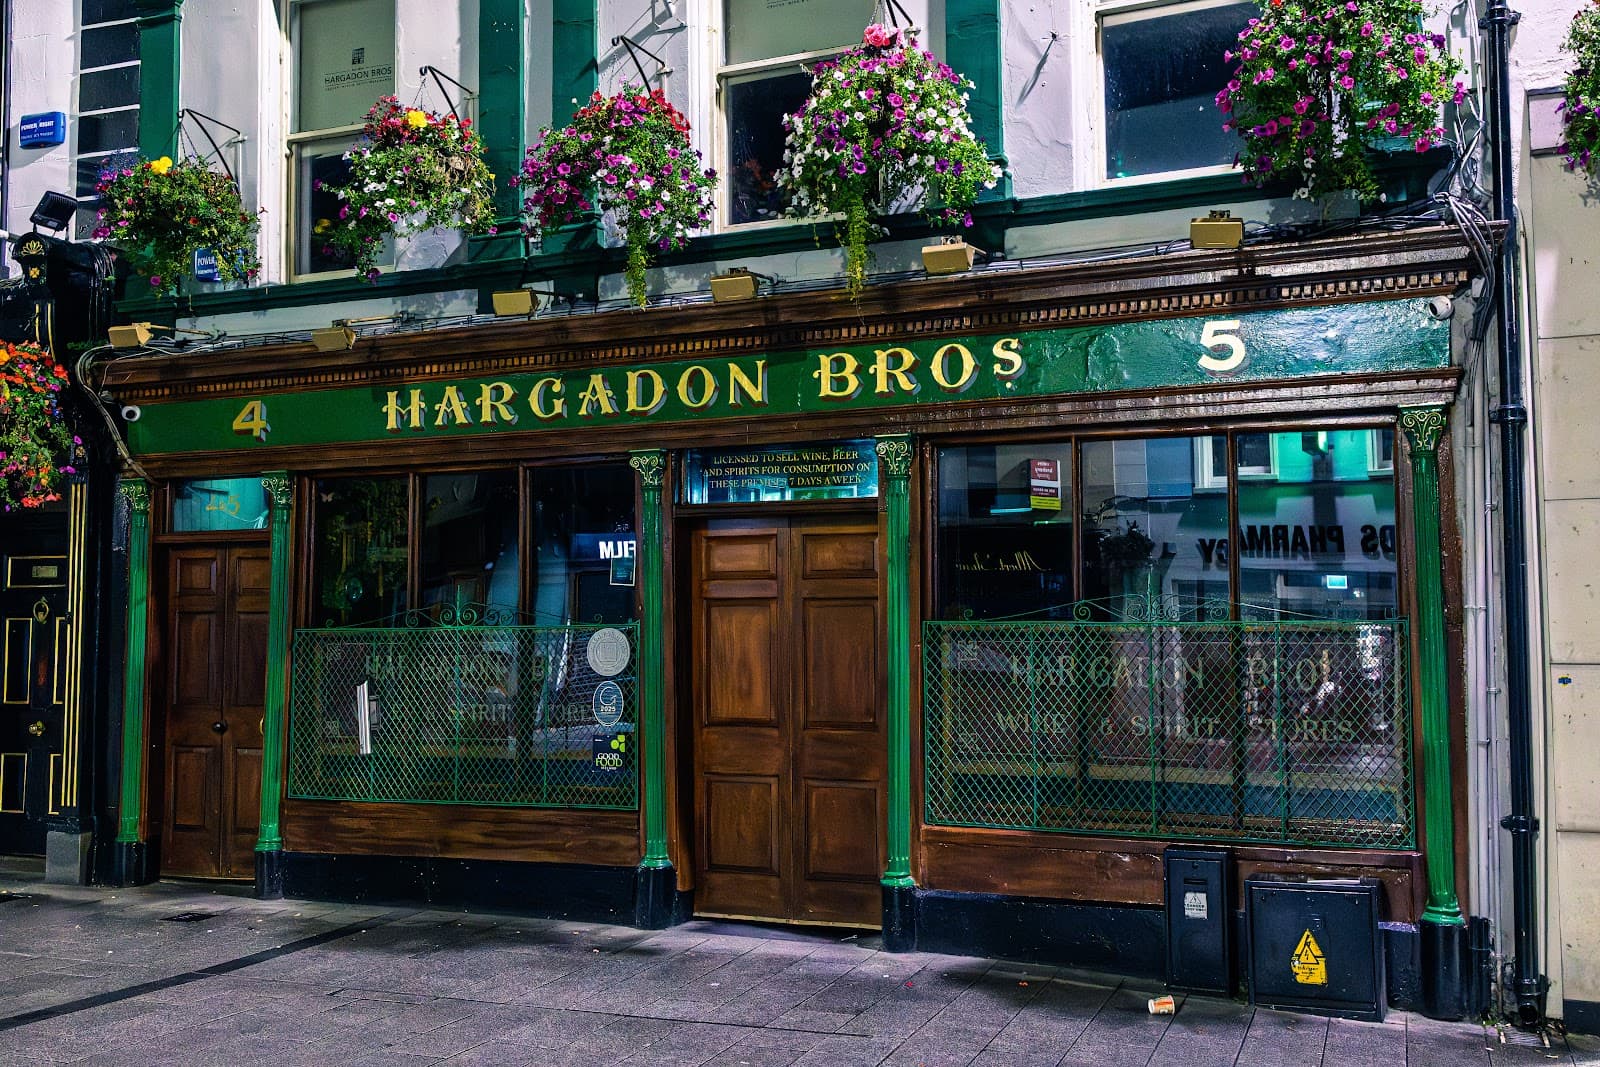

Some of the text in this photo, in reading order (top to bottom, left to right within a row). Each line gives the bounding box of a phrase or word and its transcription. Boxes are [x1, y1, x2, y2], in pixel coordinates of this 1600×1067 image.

[324, 70, 369, 85] HARGADON
[371, 66, 392, 77] BROS
[1198, 319, 1247, 376] 5
[382, 359, 768, 433] HARGADON
[232, 400, 270, 441] 4
[713, 454, 759, 465] LICENSED
[761, 454, 775, 463] TO
[776, 453, 800, 462] SELL
[832, 450, 859, 460] BEER
[703, 462, 871, 477] AND SPIRITS FOR CONSUMPTION ON
[709, 474, 862, 489] THESE PREMISES 7 DAYS A WEEK
[595, 757, 623, 767] FOOD
[597, 752, 620, 761] GOOD
